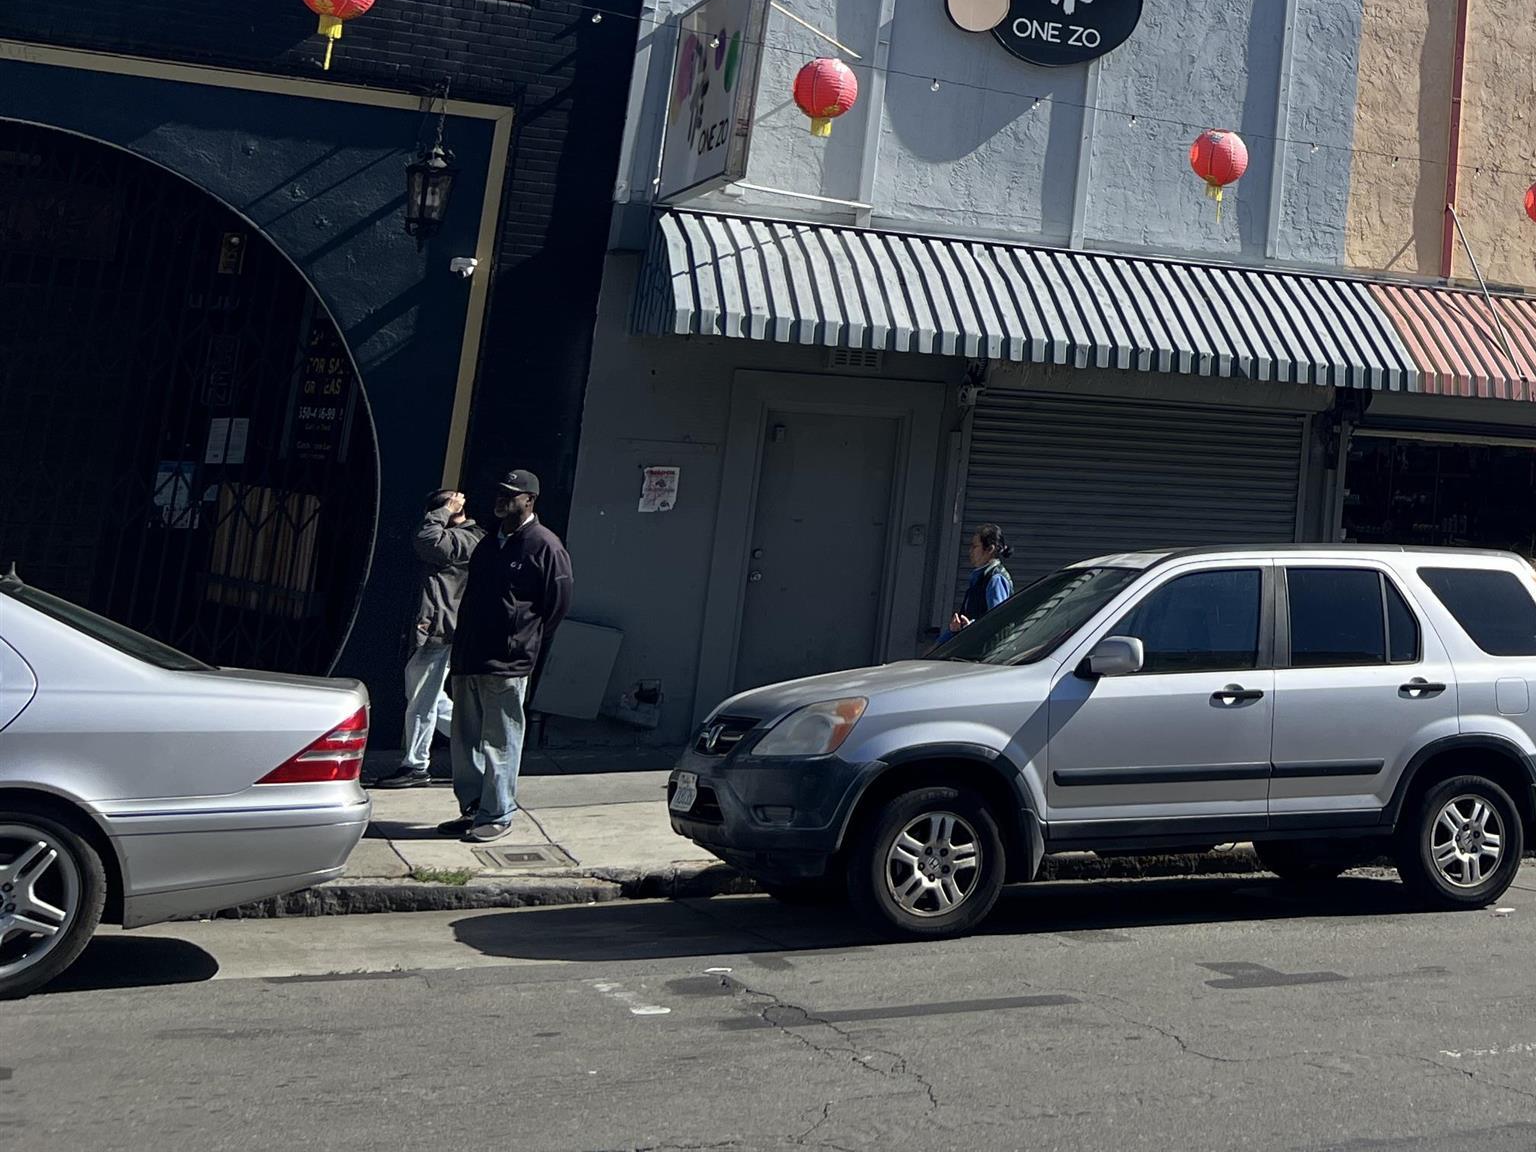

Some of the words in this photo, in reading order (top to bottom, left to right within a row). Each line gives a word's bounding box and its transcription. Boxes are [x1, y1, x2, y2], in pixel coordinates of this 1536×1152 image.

[1013, 18, 1062, 43] ONE
[1068, 26, 1101, 48] ZO
[698, 123, 717, 155] ONE
[714, 118, 730, 147] ZO
